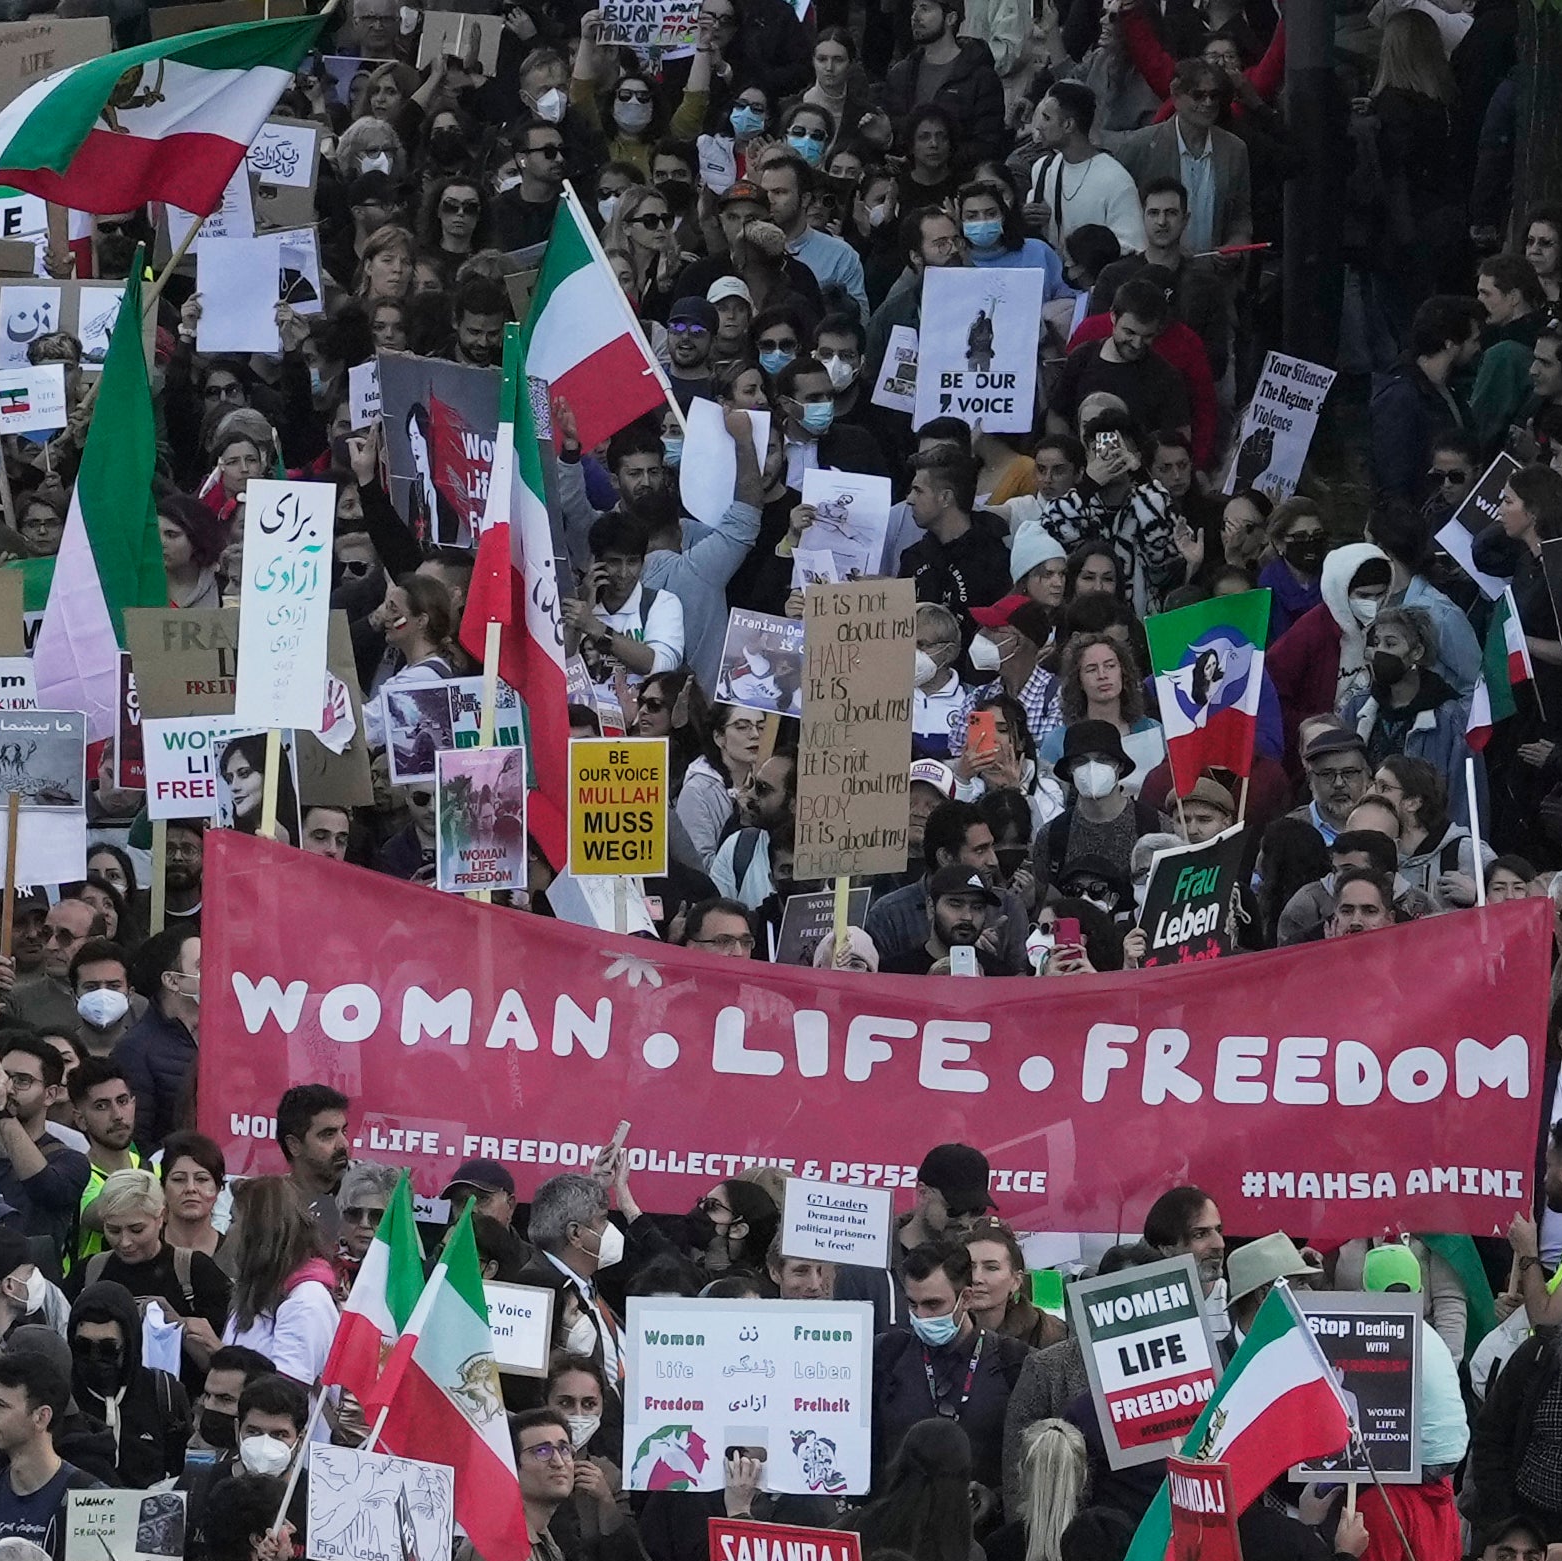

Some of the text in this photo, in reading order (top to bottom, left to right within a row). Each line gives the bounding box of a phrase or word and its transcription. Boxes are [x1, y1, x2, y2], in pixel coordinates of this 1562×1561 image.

[603, 4, 656, 21] BURN
[635, 24, 658, 43] OF
[940, 373, 1016, 389] BE OUR
[1267, 354, 1334, 391] Your Silence!
[1259, 379, 1280, 401] The
[958, 397, 1014, 414] VOICE
[1252, 403, 1294, 433] Violence
[259, 491, 315, 542] برای
[254, 544, 325, 597] آزادی
[266, 599, 308, 628] آزادی
[812, 595, 887, 617] It is not
[733, 614, 784, 636] Iranian
[838, 618, 915, 643] about my
[808, 645, 861, 678] HAIR
[808, 679, 849, 701] It is
[834, 699, 911, 723] about my
[608, 750, 630, 765] BE
[823, 750, 871, 774] is not
[579, 767, 660, 782] OUR VOICE
[579, 786, 660, 805] MULLAH
[841, 775, 908, 797] about my
[798, 795, 852, 821] BODY
[583, 810, 654, 834] MUSS
[817, 823, 908, 852] is about my
[459, 848, 508, 862] WOMAN
[583, 839, 654, 862] WEG!!
[453, 869, 513, 884] FREEDOM
[471, 860, 497, 872] LIFE
[1173, 864, 1221, 904] Frau
[1153, 902, 1221, 949] Leben
[232, 970, 612, 1060] WOMAN
[712, 1006, 1530, 1105] LIFE FREEDOM
[370, 1129, 918, 1189] LIFE FREEDOM PS752
[1241, 1166, 1524, 1200] #MAHSA AMINI
[807, 1193, 869, 1211] G7 Leaders
[807, 1210, 867, 1225] Demand that
[795, 1223, 877, 1241] political prisoners
[814, 1239, 855, 1252] be freed!
[498, 1302, 532, 1318] Voice
[1088, 1284, 1190, 1328] WOMEN
[644, 1325, 853, 1348] Woman زن Frauen
[1307, 1316, 1406, 1339] Stop Dealing
[1119, 1334, 1187, 1377] LIFE
[1365, 1340, 1390, 1353] WITH
[655, 1354, 851, 1380] Life زندگی Leben
[644, 1395, 851, 1413] Freedom Freiheit
[1109, 1380, 1216, 1423] FREEDOM
[1367, 1407, 1406, 1418] WOMEN
[1376, 1420, 1397, 1430] LIFE
[1363, 1431, 1409, 1442] FREEDOM
[87, 1513, 116, 1524] LIFE
[317, 1539, 345, 1556] Frau
